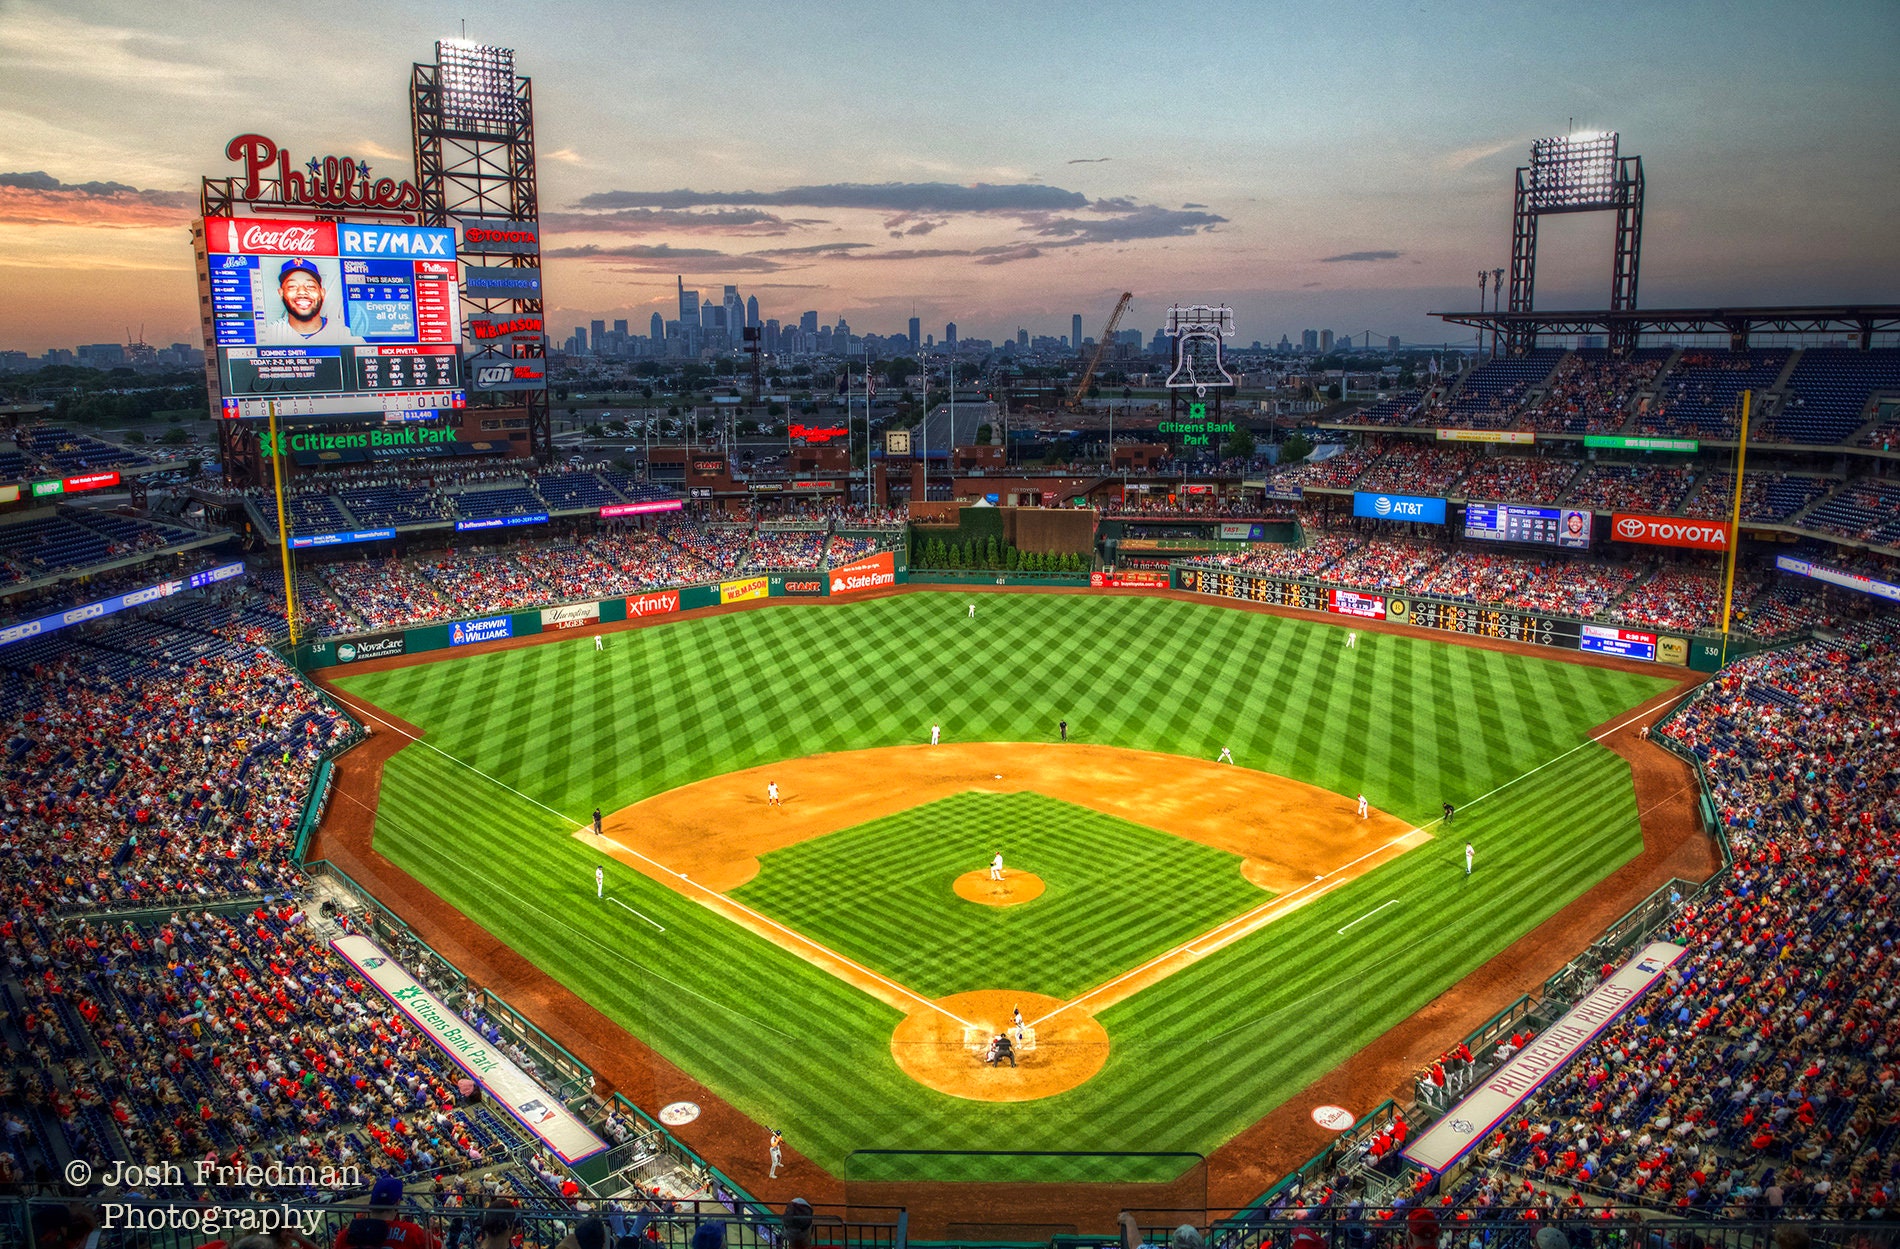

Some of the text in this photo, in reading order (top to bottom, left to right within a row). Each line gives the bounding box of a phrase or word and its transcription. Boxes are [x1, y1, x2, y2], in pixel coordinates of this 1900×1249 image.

[225, 134, 422, 210] Phillies
[243, 225, 318, 252] Coca-Cola
[344, 231, 446, 255] RE/MAX
[485, 229, 537, 244] TOYOTA
[467, 278, 528, 289] Independence
[366, 302, 410, 313] Energy for
[376, 312, 387, 320] all
[387, 312, 398, 320] of
[478, 367, 512, 383] KDI
[418, 396, 426, 408] 0
[431, 396, 437, 407] 1
[442, 396, 450, 407] 0
[1158, 421, 1236, 433] Citizens Bank
[291, 425, 457, 451] Citizens Bank Park
[1184, 434, 1209, 445] Park
[694, 462, 723, 470] GIANT
[1393, 502, 1424, 515] AT&T
[1648, 523, 1727, 544] TOYOTA
[785, 581, 820, 592] GIANT
[846, 573, 894, 589] State Farm
[123, 588, 159, 607] GEICO
[630, 595, 677, 617] xfinity
[64, 604, 104, 624] GEICO
[465, 618, 506, 632] SHERWIN
[558, 619, 584, 630] LAGER
[312, 644, 326, 653] 334
[357, 639, 404, 653] NovaCare
[1704, 647, 1719, 657] 330
[411, 998, 497, 1073] Citizens Bank Park
[1489, 983, 1633, 1098] PHILADELPHIA PHILLIES
